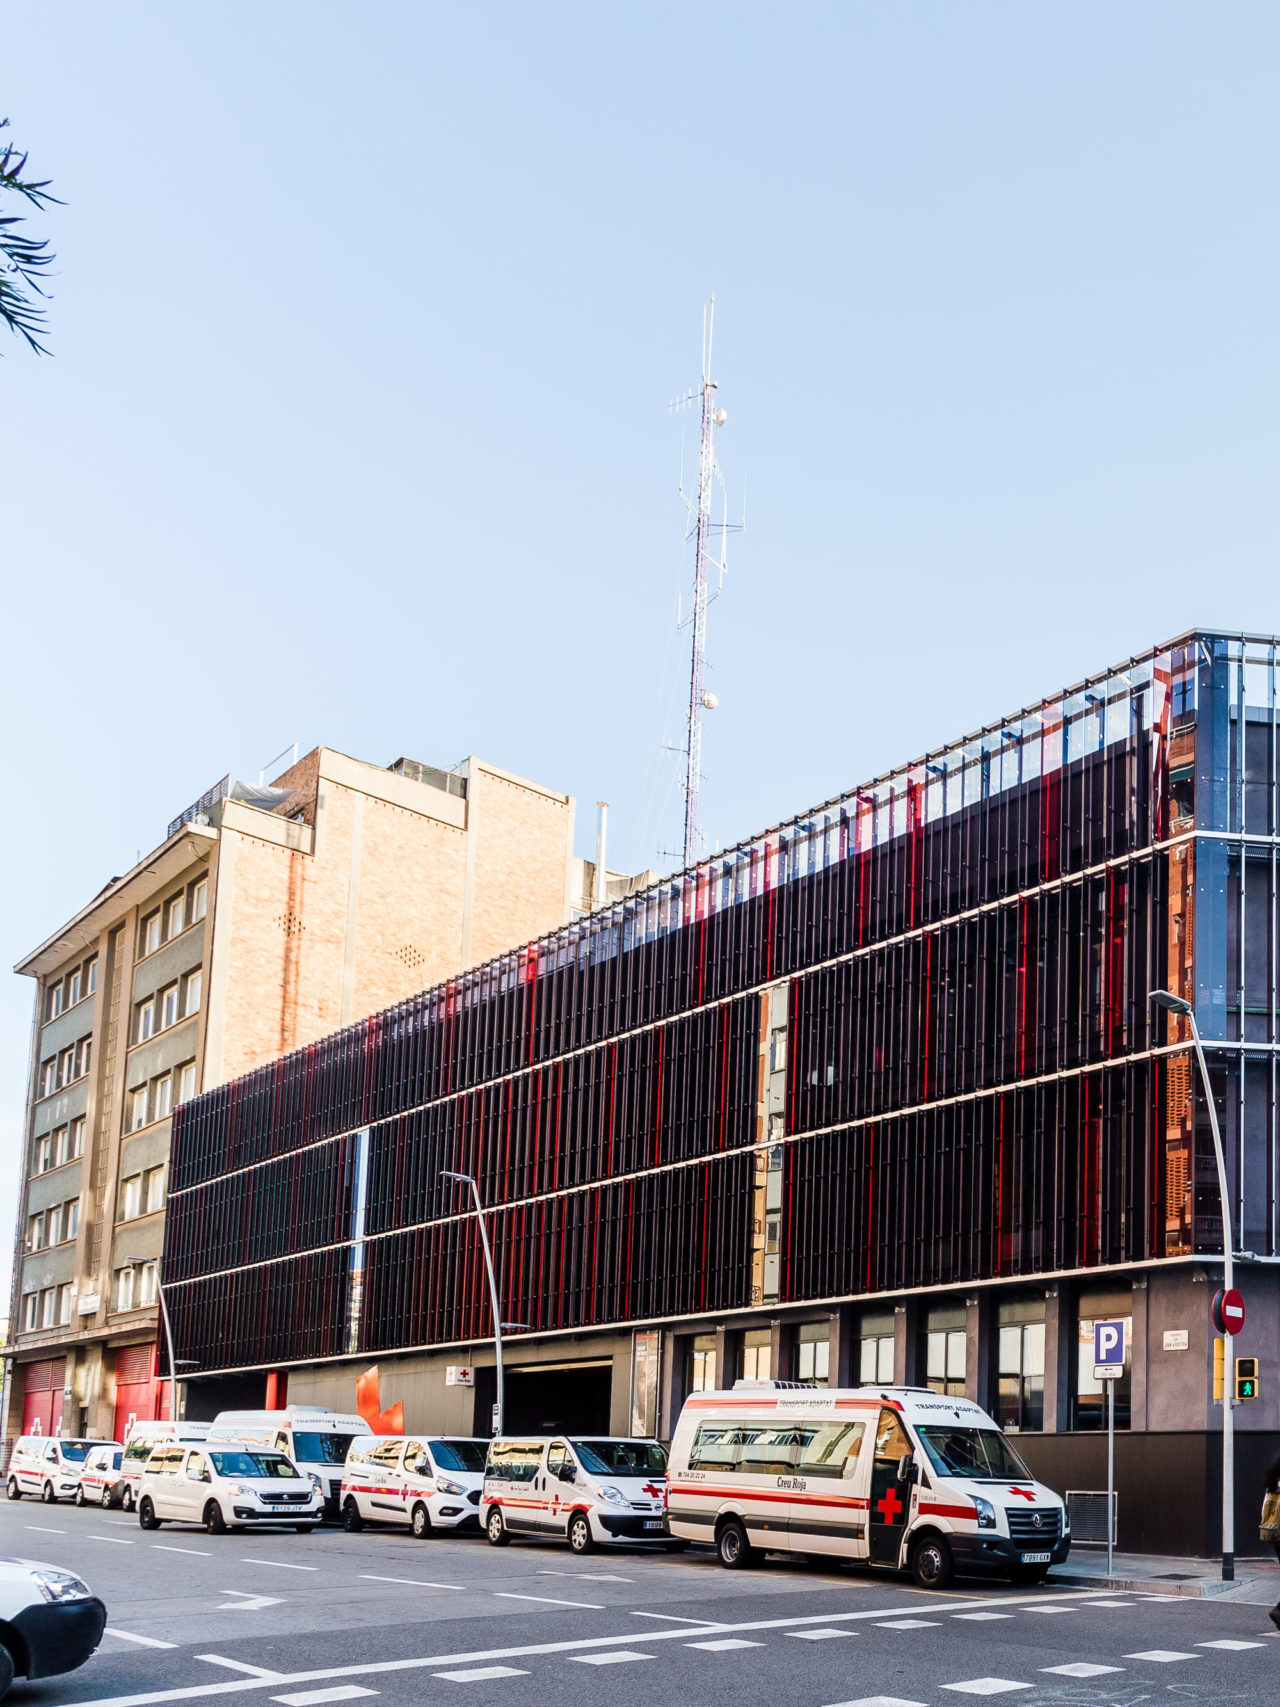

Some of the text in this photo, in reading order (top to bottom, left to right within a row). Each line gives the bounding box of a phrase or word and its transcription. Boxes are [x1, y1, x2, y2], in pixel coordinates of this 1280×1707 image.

[1099, 1326, 1119, 1360] P
[915, 1403, 955, 1411] TRANSPORT
[776, 1476, 807, 1492] Creu Roja
